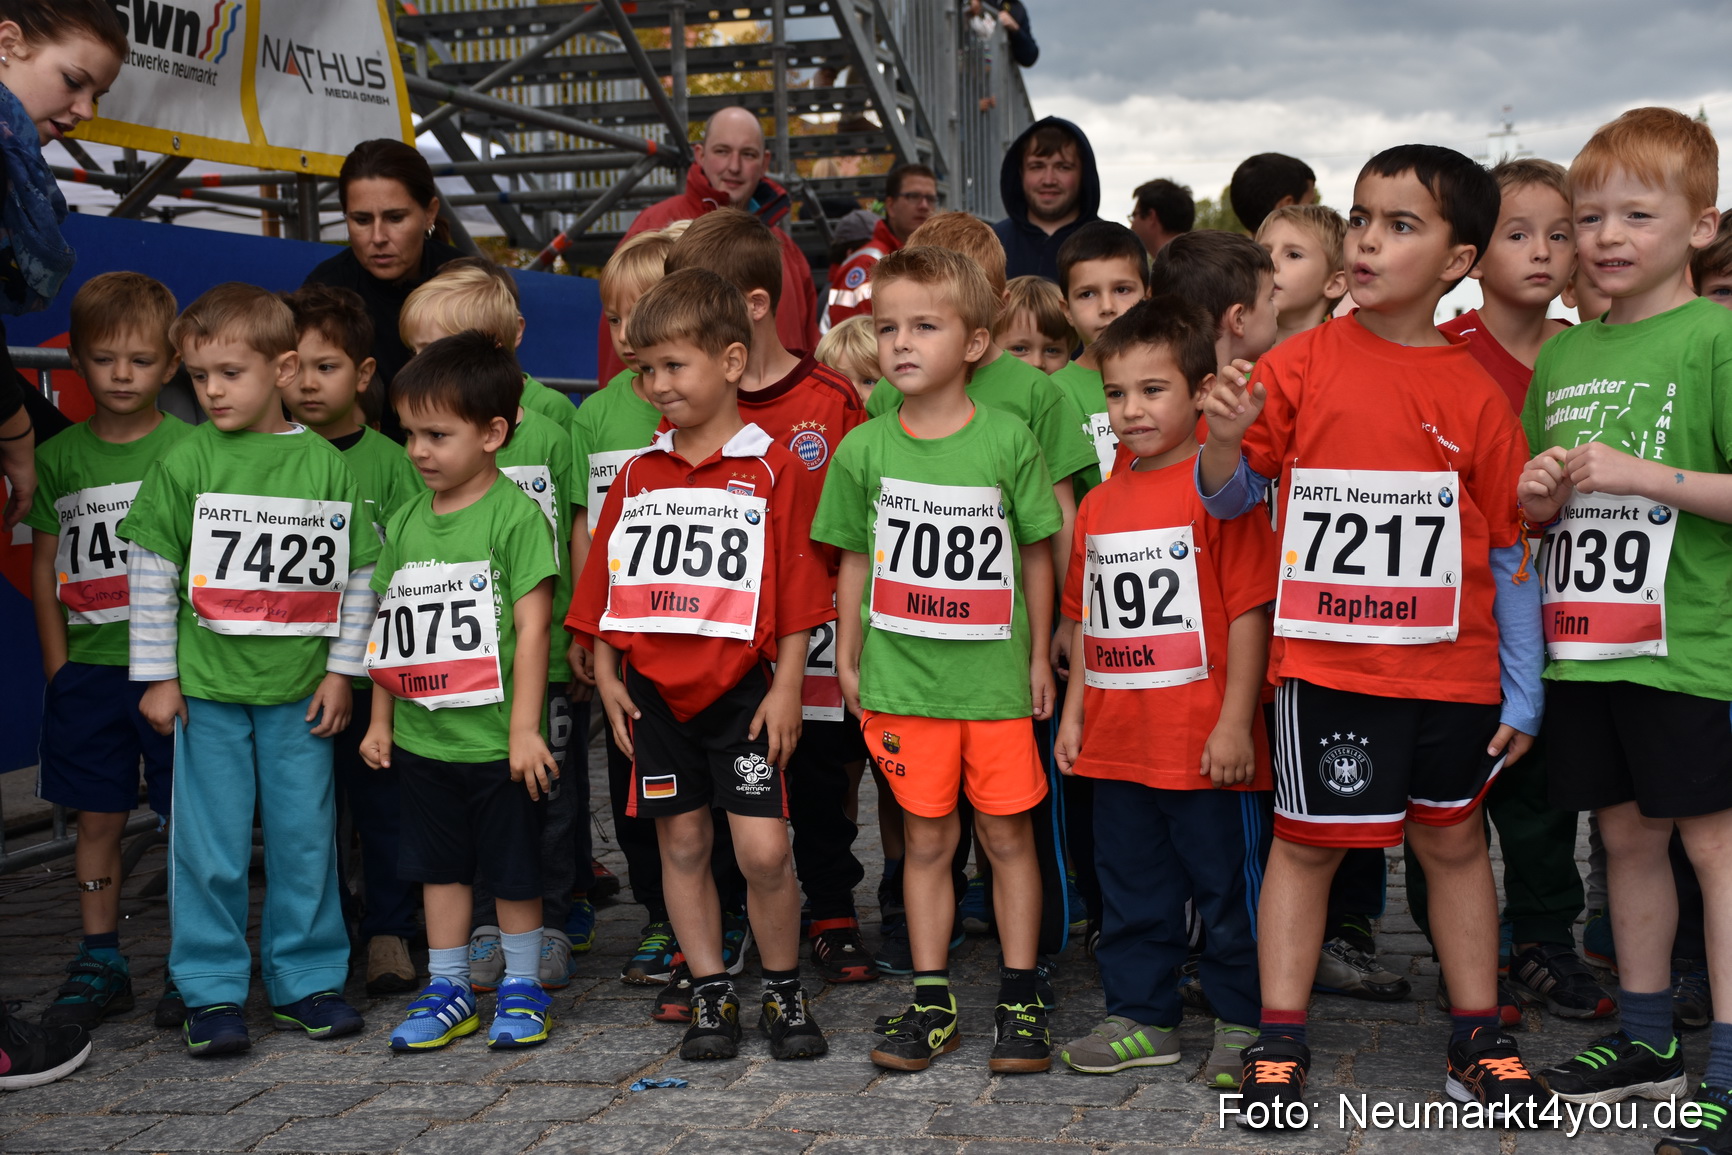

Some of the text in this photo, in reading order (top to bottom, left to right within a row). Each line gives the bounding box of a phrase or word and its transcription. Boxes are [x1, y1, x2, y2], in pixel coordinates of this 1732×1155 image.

[124, 49, 219, 86] twerke neumarkt
[262, 34, 386, 94] NATHUS
[325, 87, 390, 106] MEDIA GMBH
[881, 493, 920, 513] PARTL
[923, 500, 994, 517] Neumarkt
[1293, 485, 1432, 505] PARTL Neumarkt
[86, 499, 135, 515] Neum
[199, 507, 325, 528] PARTL Neumarkt
[622, 503, 739, 521] PARTL Neumarkt
[1563, 505, 1640, 521] Neumarkt
[66, 517, 127, 575] 74
[625, 524, 749, 582] 7058
[887, 518, 1003, 582] 7082
[1303, 511, 1446, 577] 7217
[211, 529, 336, 586] 7423
[1097, 547, 1163, 565] eumarkt
[1544, 529, 1651, 594] 7039
[398, 579, 464, 598] Neumarkt
[651, 590, 700, 613] Vitus
[906, 591, 970, 619] Niklas
[1317, 591, 1417, 623] Raphael
[377, 599, 482, 660] 7075
[1554, 610, 1589, 635] Finn
[1096, 645, 1156, 668] Patrick
[399, 672, 449, 694] Timur
[877, 755, 906, 777] FCB
[1325, 748, 1366, 764] DEUTSCHLAND
[1016, 1013, 1036, 1023] LICO
